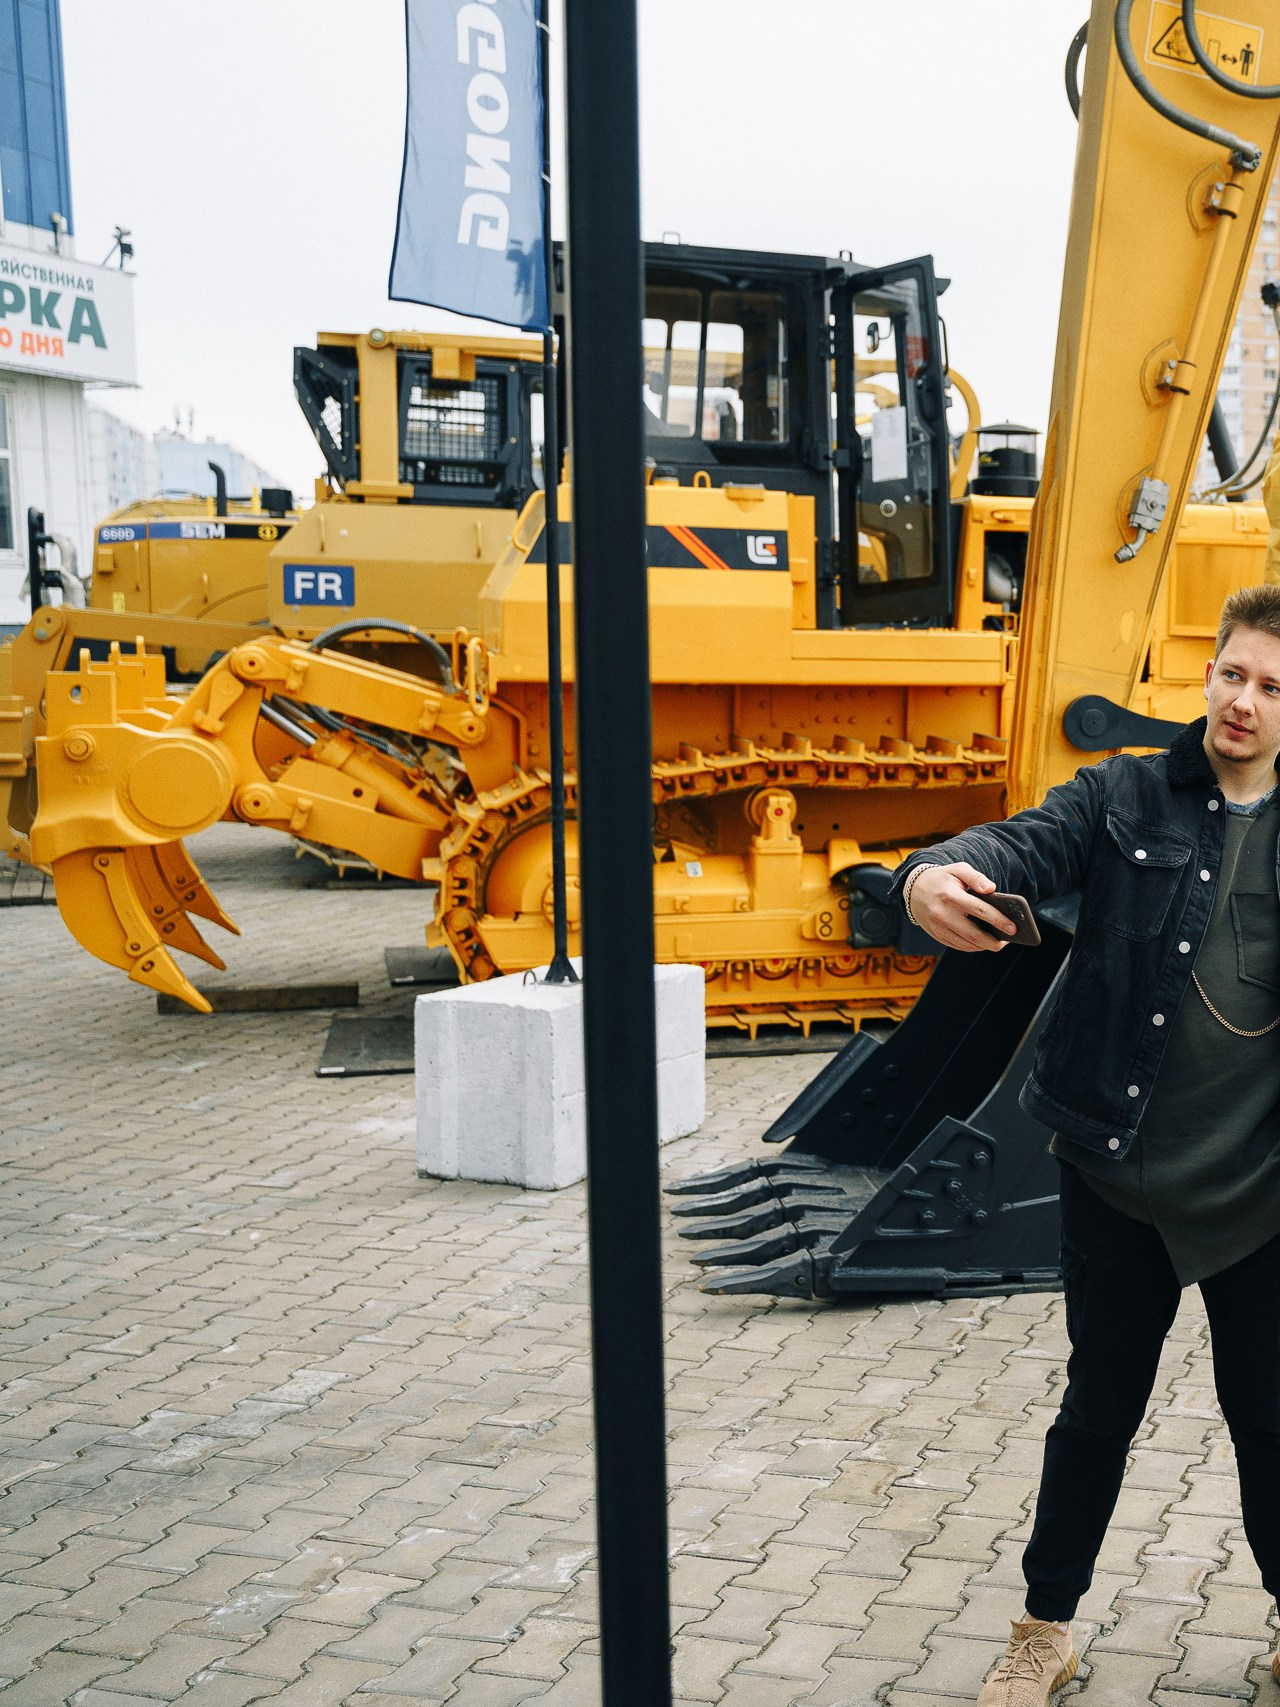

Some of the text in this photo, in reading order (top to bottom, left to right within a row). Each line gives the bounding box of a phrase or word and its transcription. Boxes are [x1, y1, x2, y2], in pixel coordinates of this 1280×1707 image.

[21, 331, 64, 357] ДНЯ
[180, 522, 226, 539] SEM
[294, 571, 343, 601] FR
